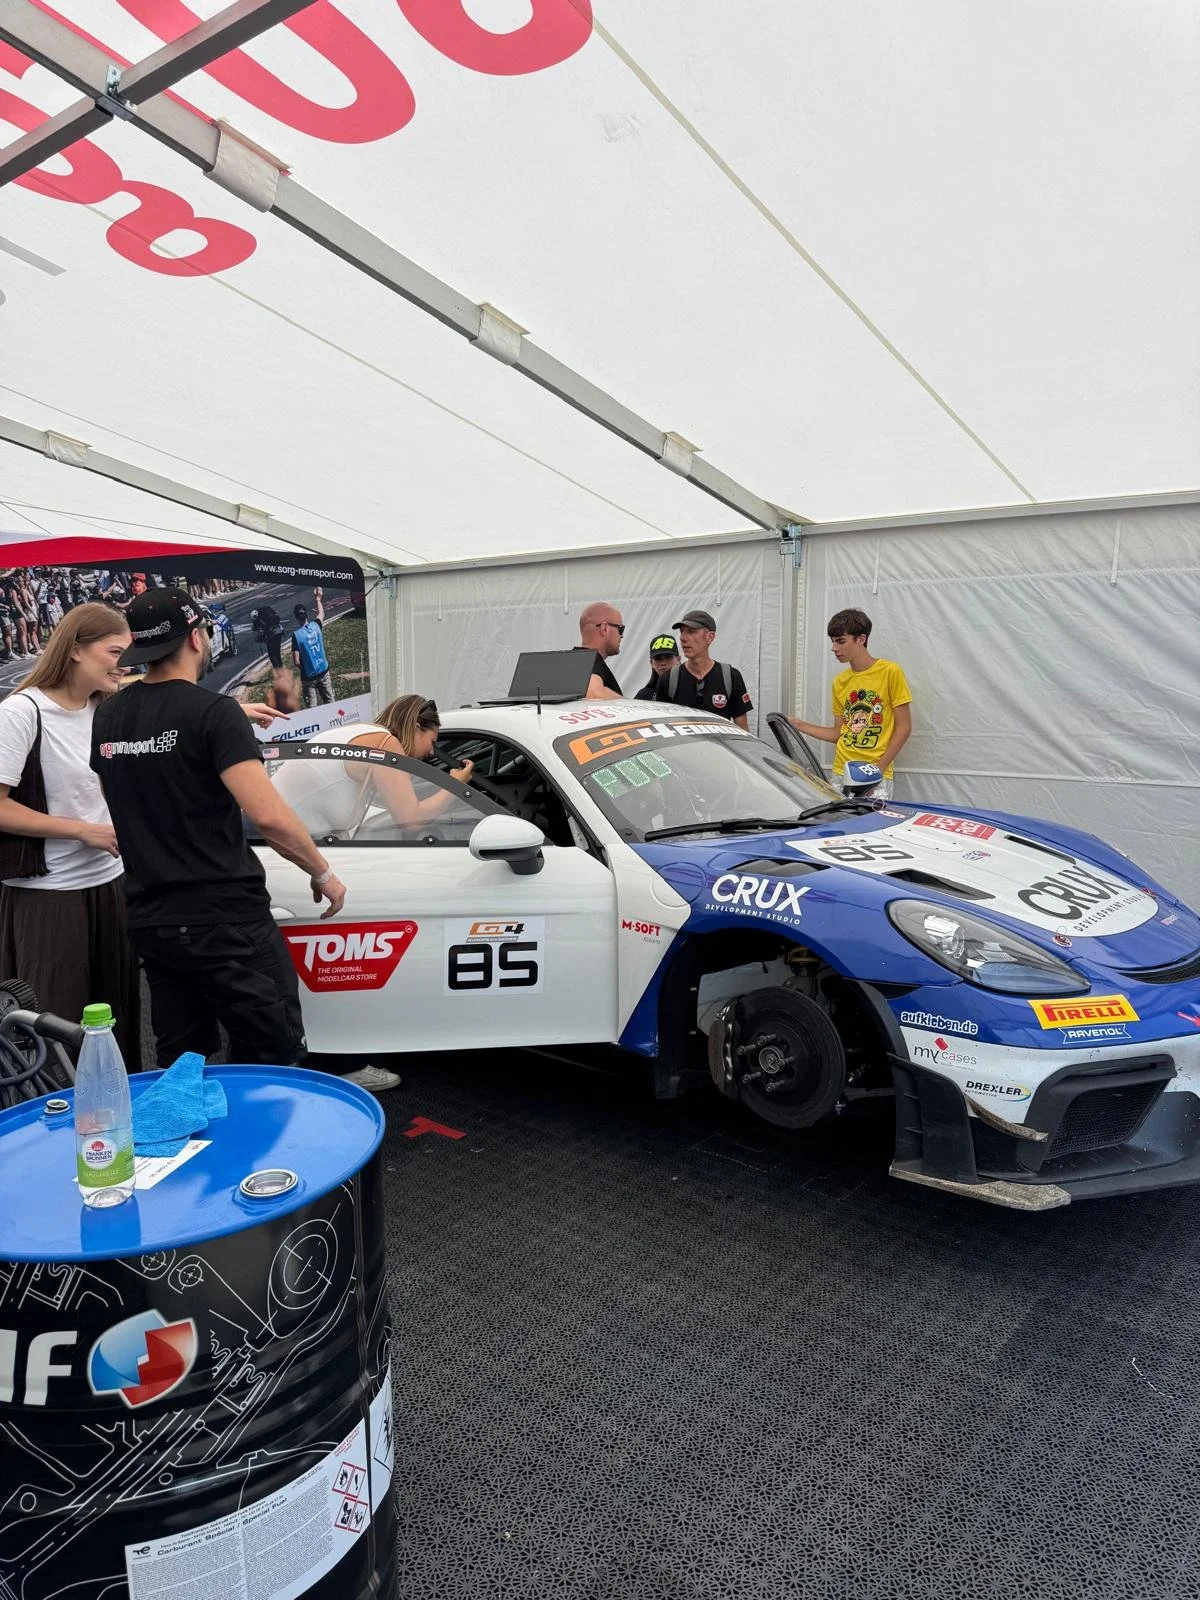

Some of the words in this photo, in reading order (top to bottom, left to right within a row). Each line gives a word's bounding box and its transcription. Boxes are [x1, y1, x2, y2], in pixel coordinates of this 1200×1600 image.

[254, 563, 354, 580] www.sorg-rennsport.com
[652, 635, 674, 650] 46
[558, 708, 616, 725] sorg
[272, 723, 320, 743] FALKEN
[310, 745, 327, 755] de
[331, 746, 367, 758] Groot
[711, 874, 812, 916] CRUX
[1017, 865, 1129, 920] CRUX
[705, 904, 763, 917] DEVELOPMENT
[766, 913, 800, 925] STUDIO
[1073, 900, 1126, 932] DEVELOPMENT
[287, 931, 405, 973] TOMS
[331, 966, 363, 974] ORIGINAL
[448, 941, 538, 990] 85
[317, 975, 355, 983] MODELCAR
[355, 973, 378, 981] STORE
[1040, 1000, 1127, 1022] PIRELLI
[900, 1011, 979, 1035] aufkleben.de
[1067, 1027, 1122, 1039] RAVENOL
[964, 1089, 998, 1098] AUTOMOTIVE
[966, 1080, 1022, 1096] DREXLER
[157, 1538, 201, 1556] Carburant
[205, 1525, 235, 1541] Spécial
[242, 1508, 270, 1526] Special
[271, 1497, 287, 1510] Fuel
